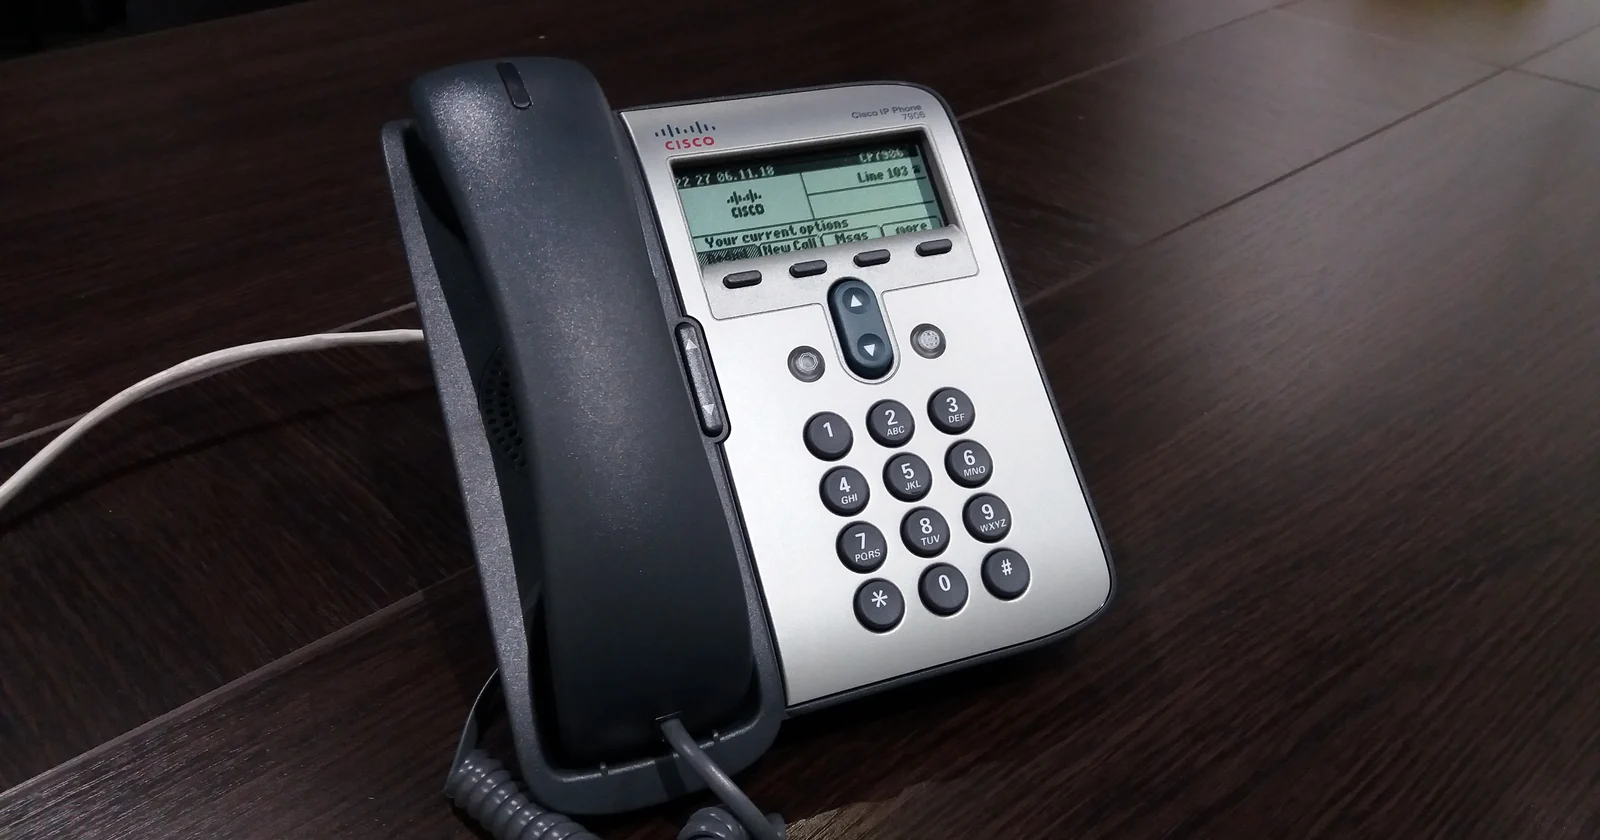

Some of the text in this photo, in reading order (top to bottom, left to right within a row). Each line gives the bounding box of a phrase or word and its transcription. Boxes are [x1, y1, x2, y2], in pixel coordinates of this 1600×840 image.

[851, 111, 878, 119] Cisco
[892, 105, 922, 113] Phone
[665, 136, 715, 150] CISCO
[857, 165, 909, 183] Line 103
[704, 219, 849, 248] Your current options
[762, 235, 818, 256] New Call
[945, 396, 959, 413] 3
[884, 409, 898, 425] 2
[948, 413, 965, 424] DEF
[822, 421, 834, 438] 1
[886, 425, 905, 437] ABC
[963, 449, 976, 466] 6
[901, 463, 914, 479] 5
[963, 465, 986, 477] MNO
[839, 476, 851, 493] 4
[904, 480, 921, 491] JKL
[841, 493, 858, 505] GHI
[981, 503, 994, 520] 9
[919, 517, 933, 534] 8
[979, 518, 1006, 533] WXYZ
[855, 532, 866, 549] 7
[920, 534, 940, 546] TUV
[854, 548, 881, 562] PQRS
[938, 574, 951, 592] 0
